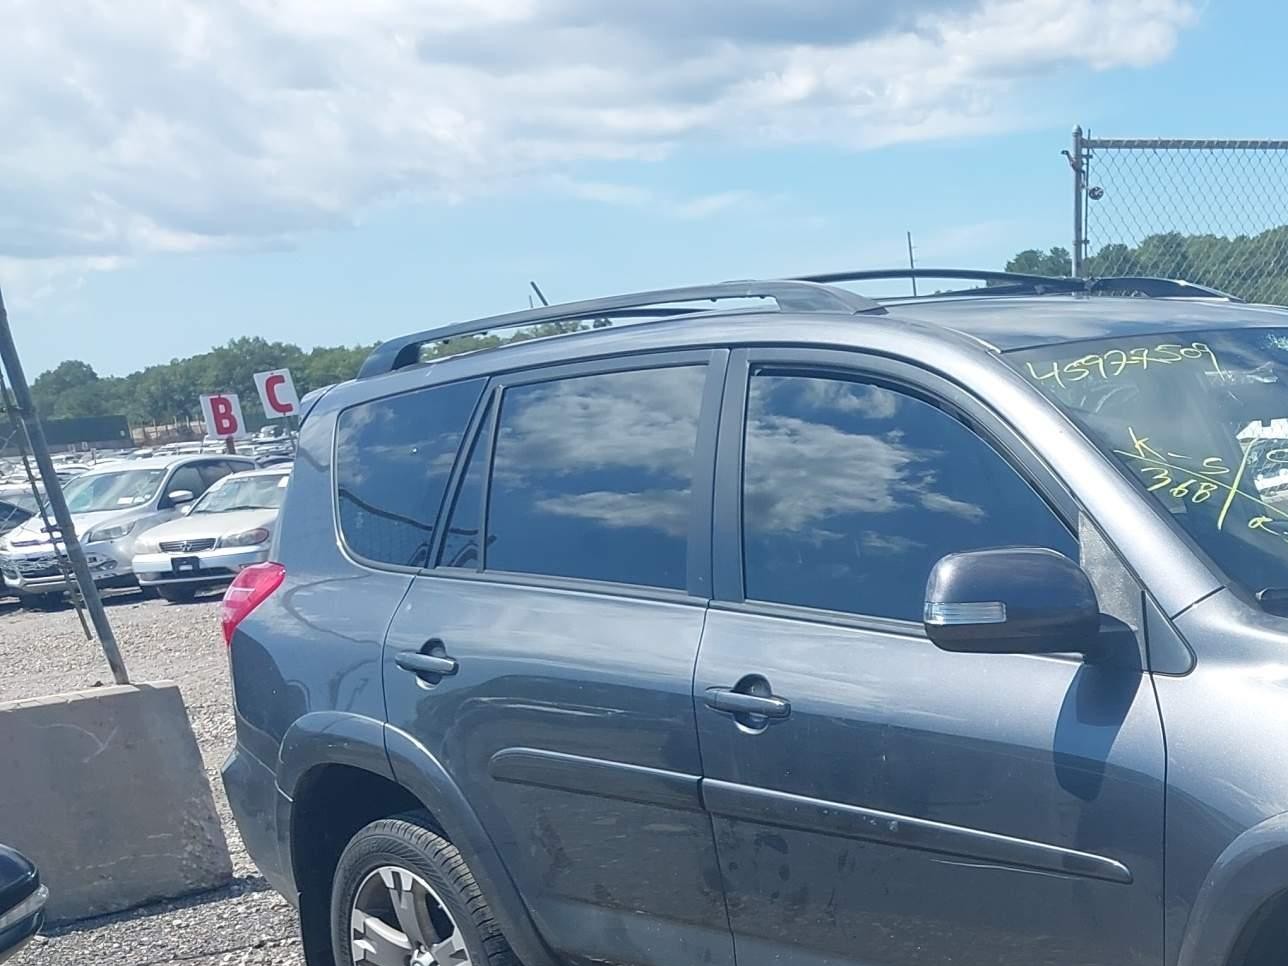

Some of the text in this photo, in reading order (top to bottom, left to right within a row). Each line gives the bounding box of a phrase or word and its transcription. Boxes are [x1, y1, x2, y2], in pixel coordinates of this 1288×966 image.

[1026, 342, 1225, 389] 45977509
[265, 374, 294, 413] C
[209, 396, 238, 436] B
[1140, 466, 1219, 503] 368
